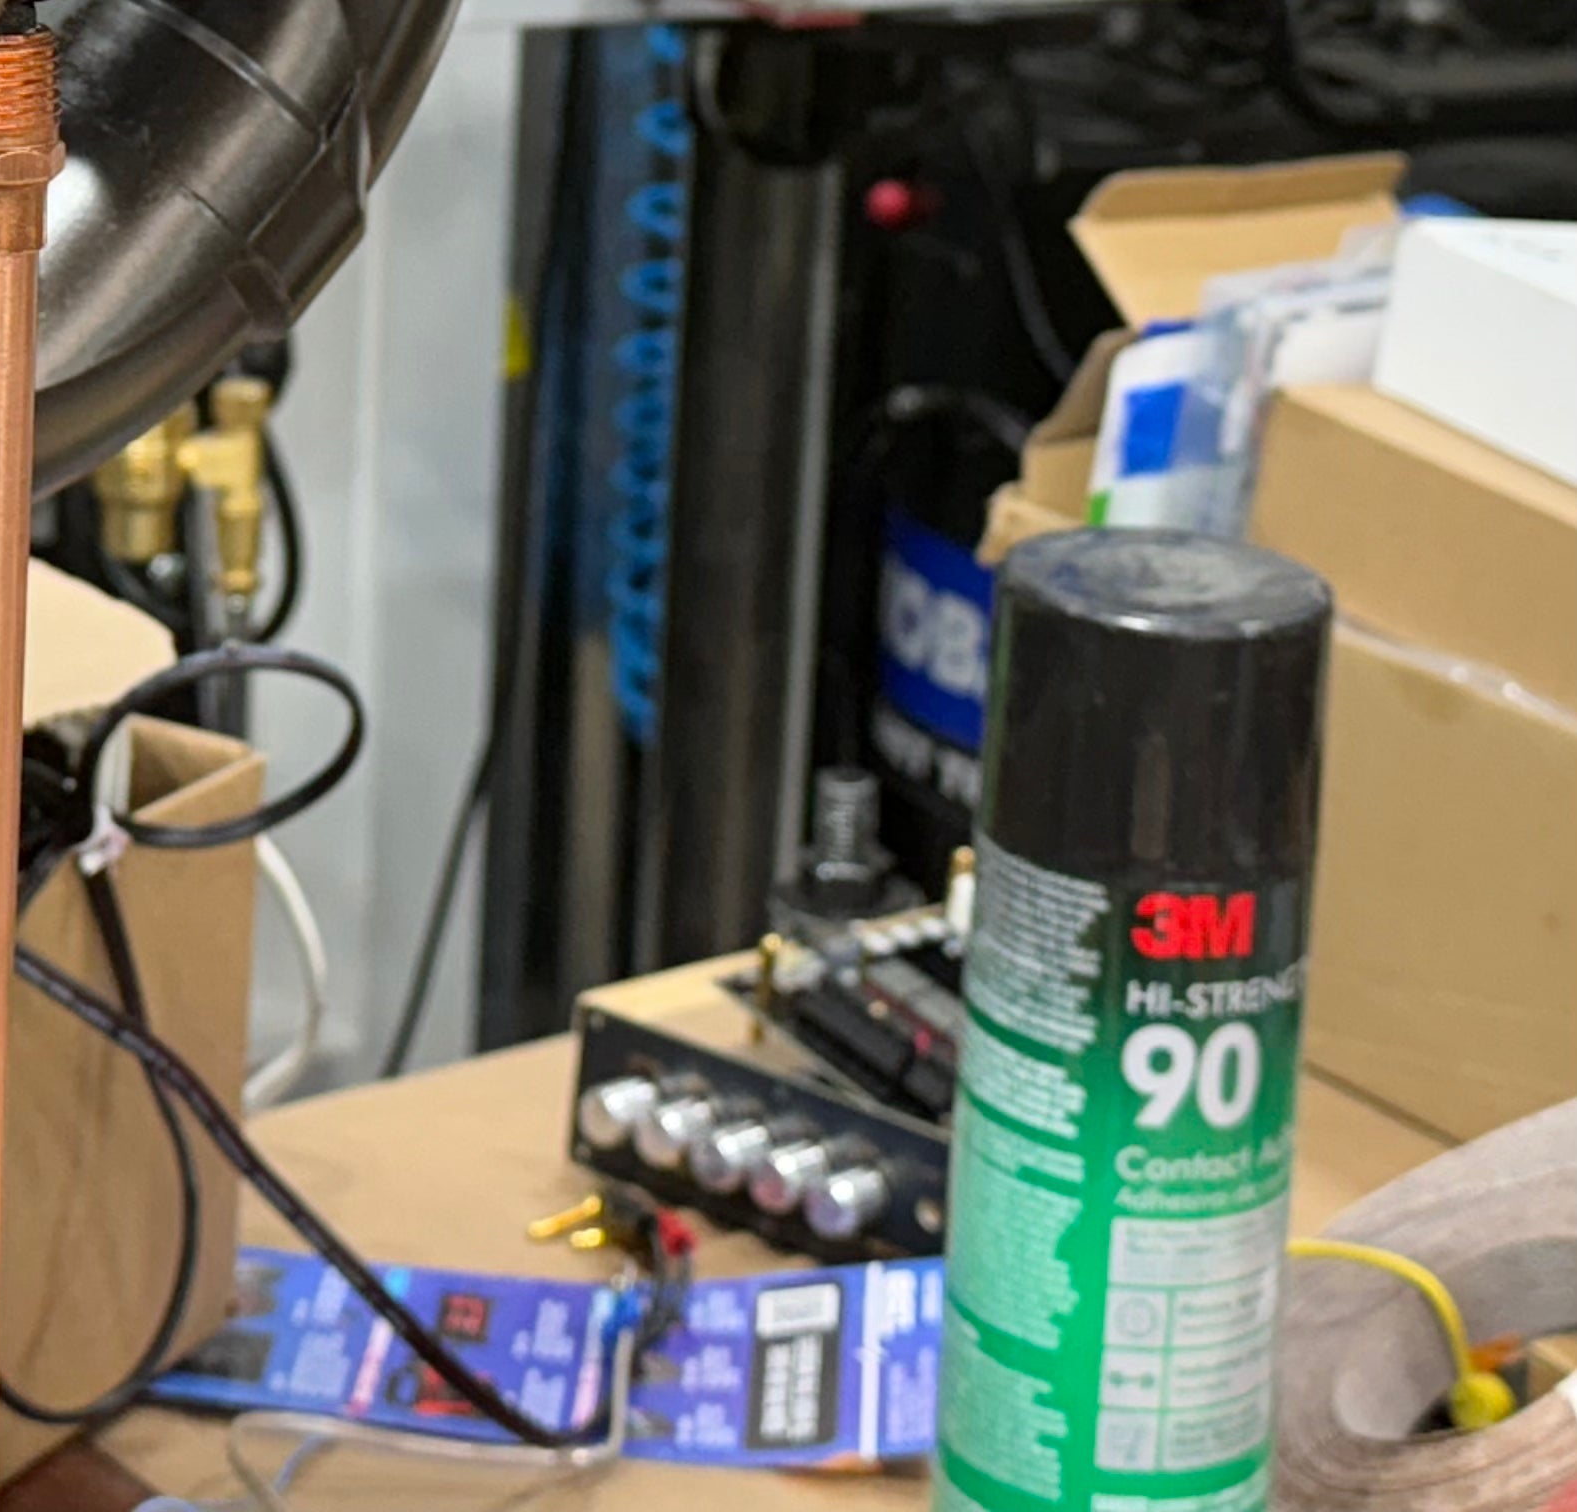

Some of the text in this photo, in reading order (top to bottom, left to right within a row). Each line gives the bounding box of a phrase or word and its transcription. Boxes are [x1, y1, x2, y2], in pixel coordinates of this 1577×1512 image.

[1131, 890, 1256, 961] 3M
[1122, 1022, 1261, 1129] 90
[1114, 1144, 1252, 1182] Contact
